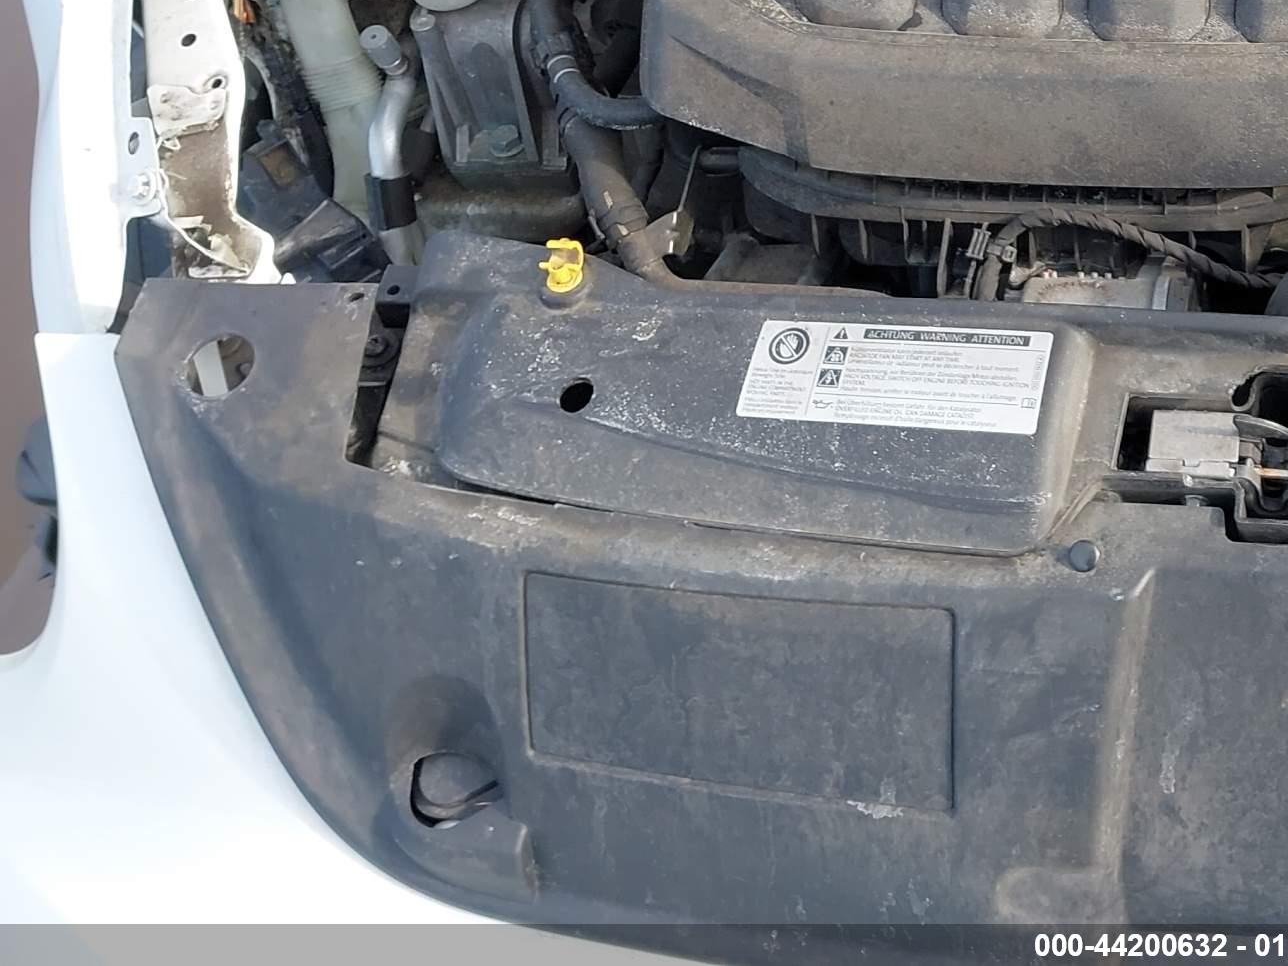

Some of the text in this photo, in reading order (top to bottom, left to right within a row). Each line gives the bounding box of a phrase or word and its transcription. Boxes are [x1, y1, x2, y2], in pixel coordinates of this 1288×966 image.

[866, 329, 1025, 345] ACHTUNG WARNING ATTENTION
